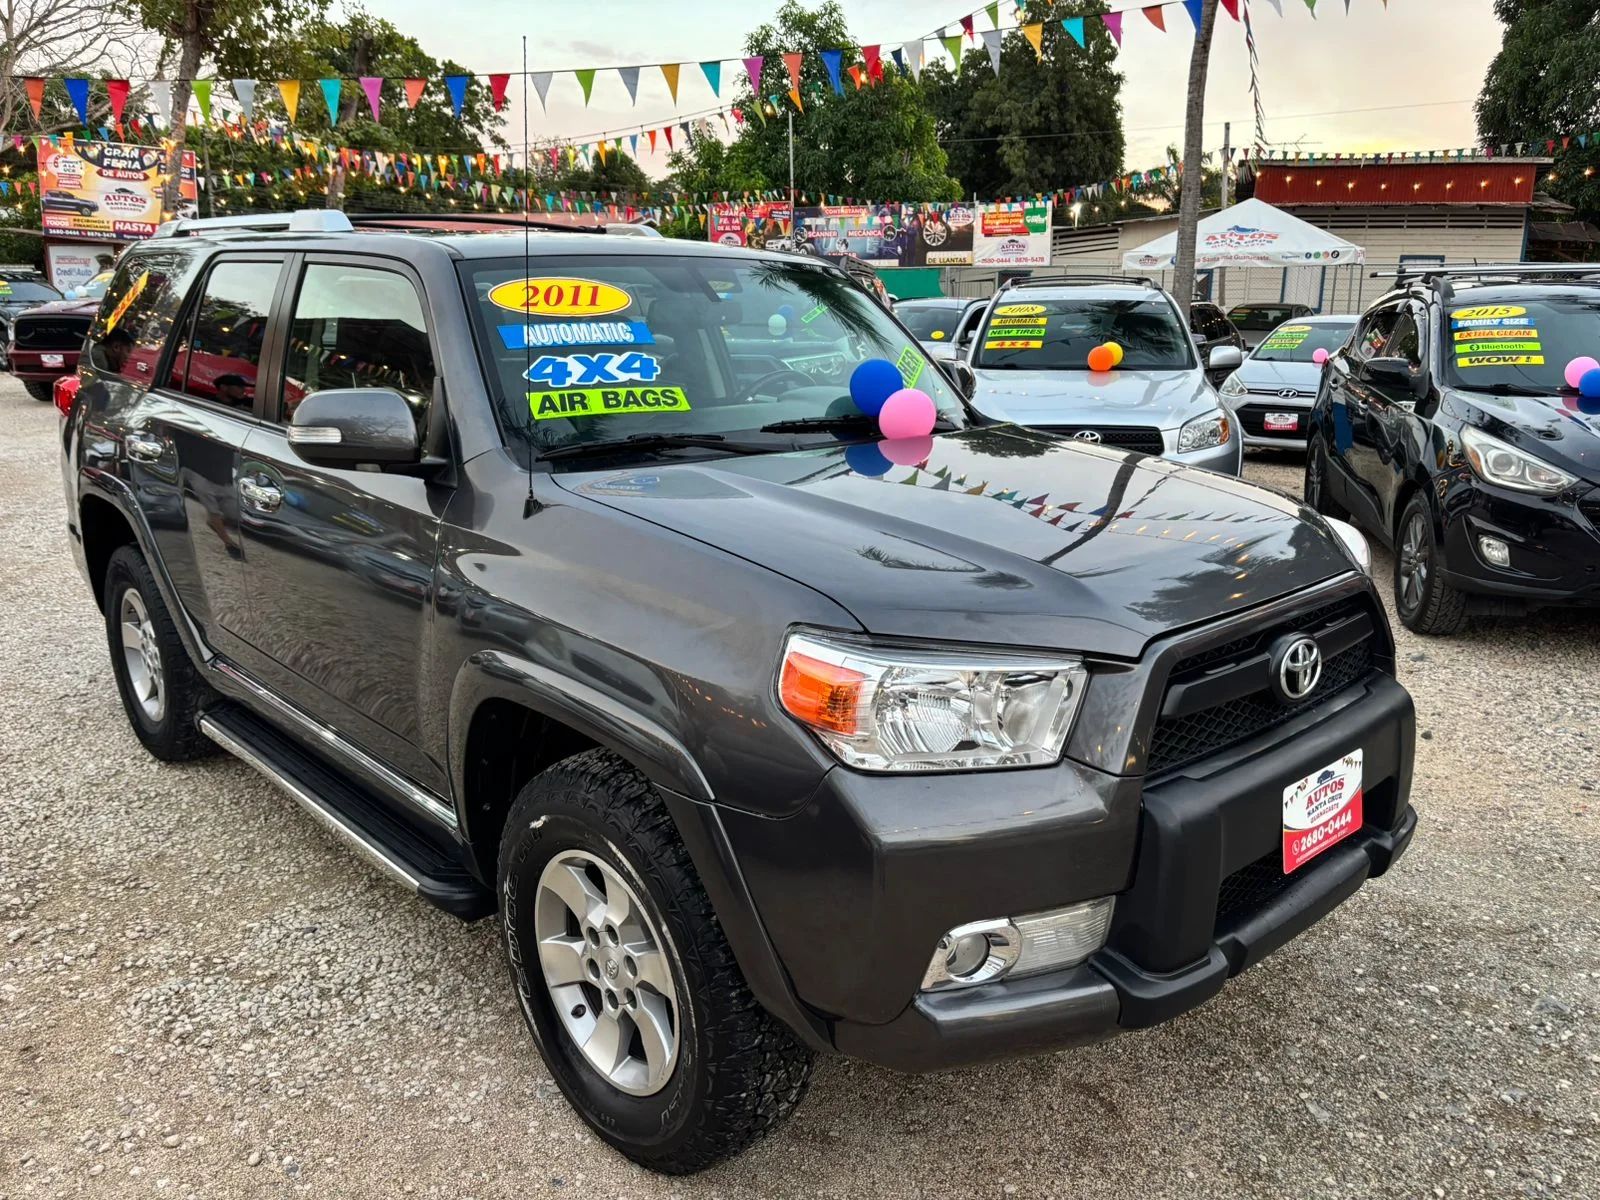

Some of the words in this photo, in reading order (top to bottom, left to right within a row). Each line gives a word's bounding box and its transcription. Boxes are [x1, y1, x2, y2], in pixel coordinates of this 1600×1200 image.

[103, 147, 139, 159] GRAN
[103, 158, 141, 170] FERIA
[102, 169, 115, 177] DE
[115, 169, 145, 180] AUTOS
[104, 194, 147, 204] AUTOS
[115, 221, 153, 233] HASTA
[848, 229, 882, 237] MECÁNICA
[1204, 232, 1279, 241] AUTOS
[520, 284, 600, 307] 2011
[1463, 306, 1512, 317] 2015
[1457, 318, 1501, 327] FAMILY
[1502, 317, 1529, 325] SIZE
[523, 321, 635, 346] AUTOMATIC
[1458, 330, 1495, 338] EXTRA
[1468, 356, 1520, 364] WOW
[525, 352, 660, 386] 4X4
[537, 391, 590, 415] AIR
[601, 388, 680, 410] BAGS
[1306, 777, 1345, 810] AUTOS
[1307, 800, 1327, 818] SANTA
[1327, 792, 1343, 804] CRUZ
[1300, 808, 1352, 851] 2680-0444
